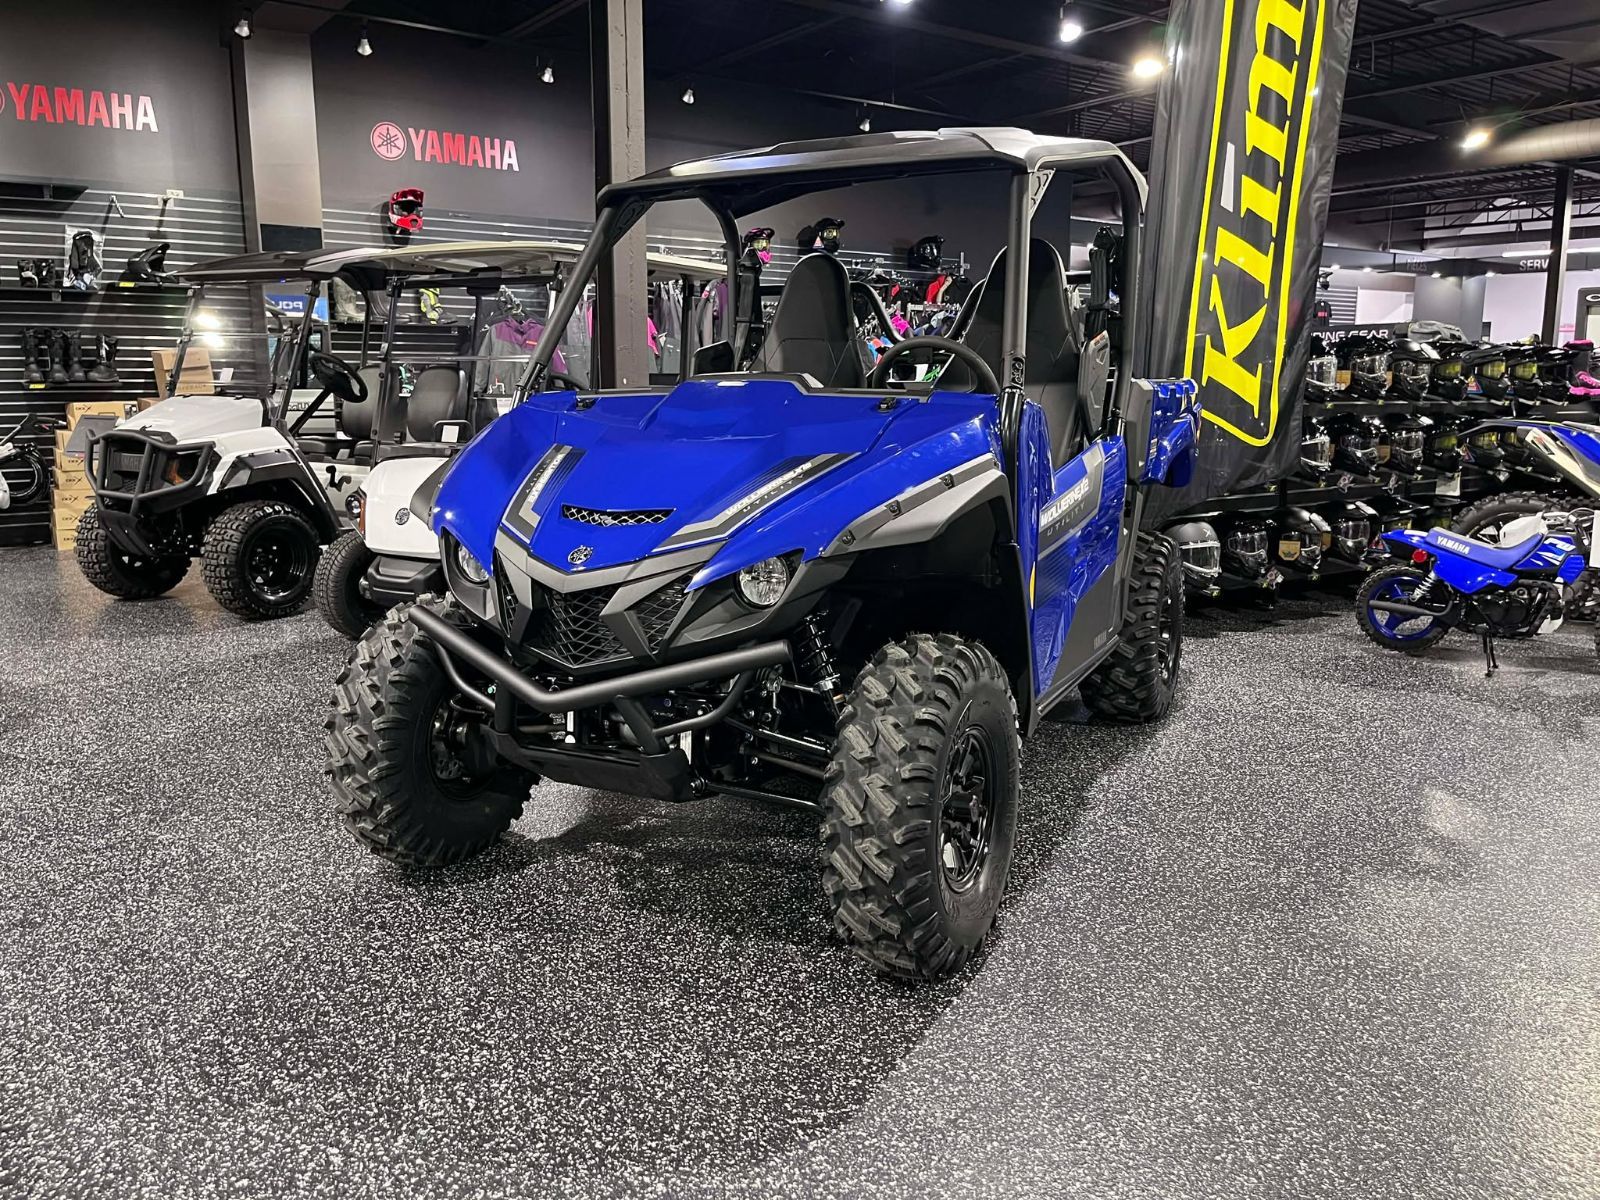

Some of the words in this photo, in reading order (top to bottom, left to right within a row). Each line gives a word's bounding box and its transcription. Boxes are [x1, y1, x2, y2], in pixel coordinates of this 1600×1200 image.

[7, 82, 159, 132] YAMAHA
[408, 127, 520, 172] YAMAHA
[1046, 501, 1085, 537] UTILITY
[1436, 535, 1471, 555] YAMAHA
